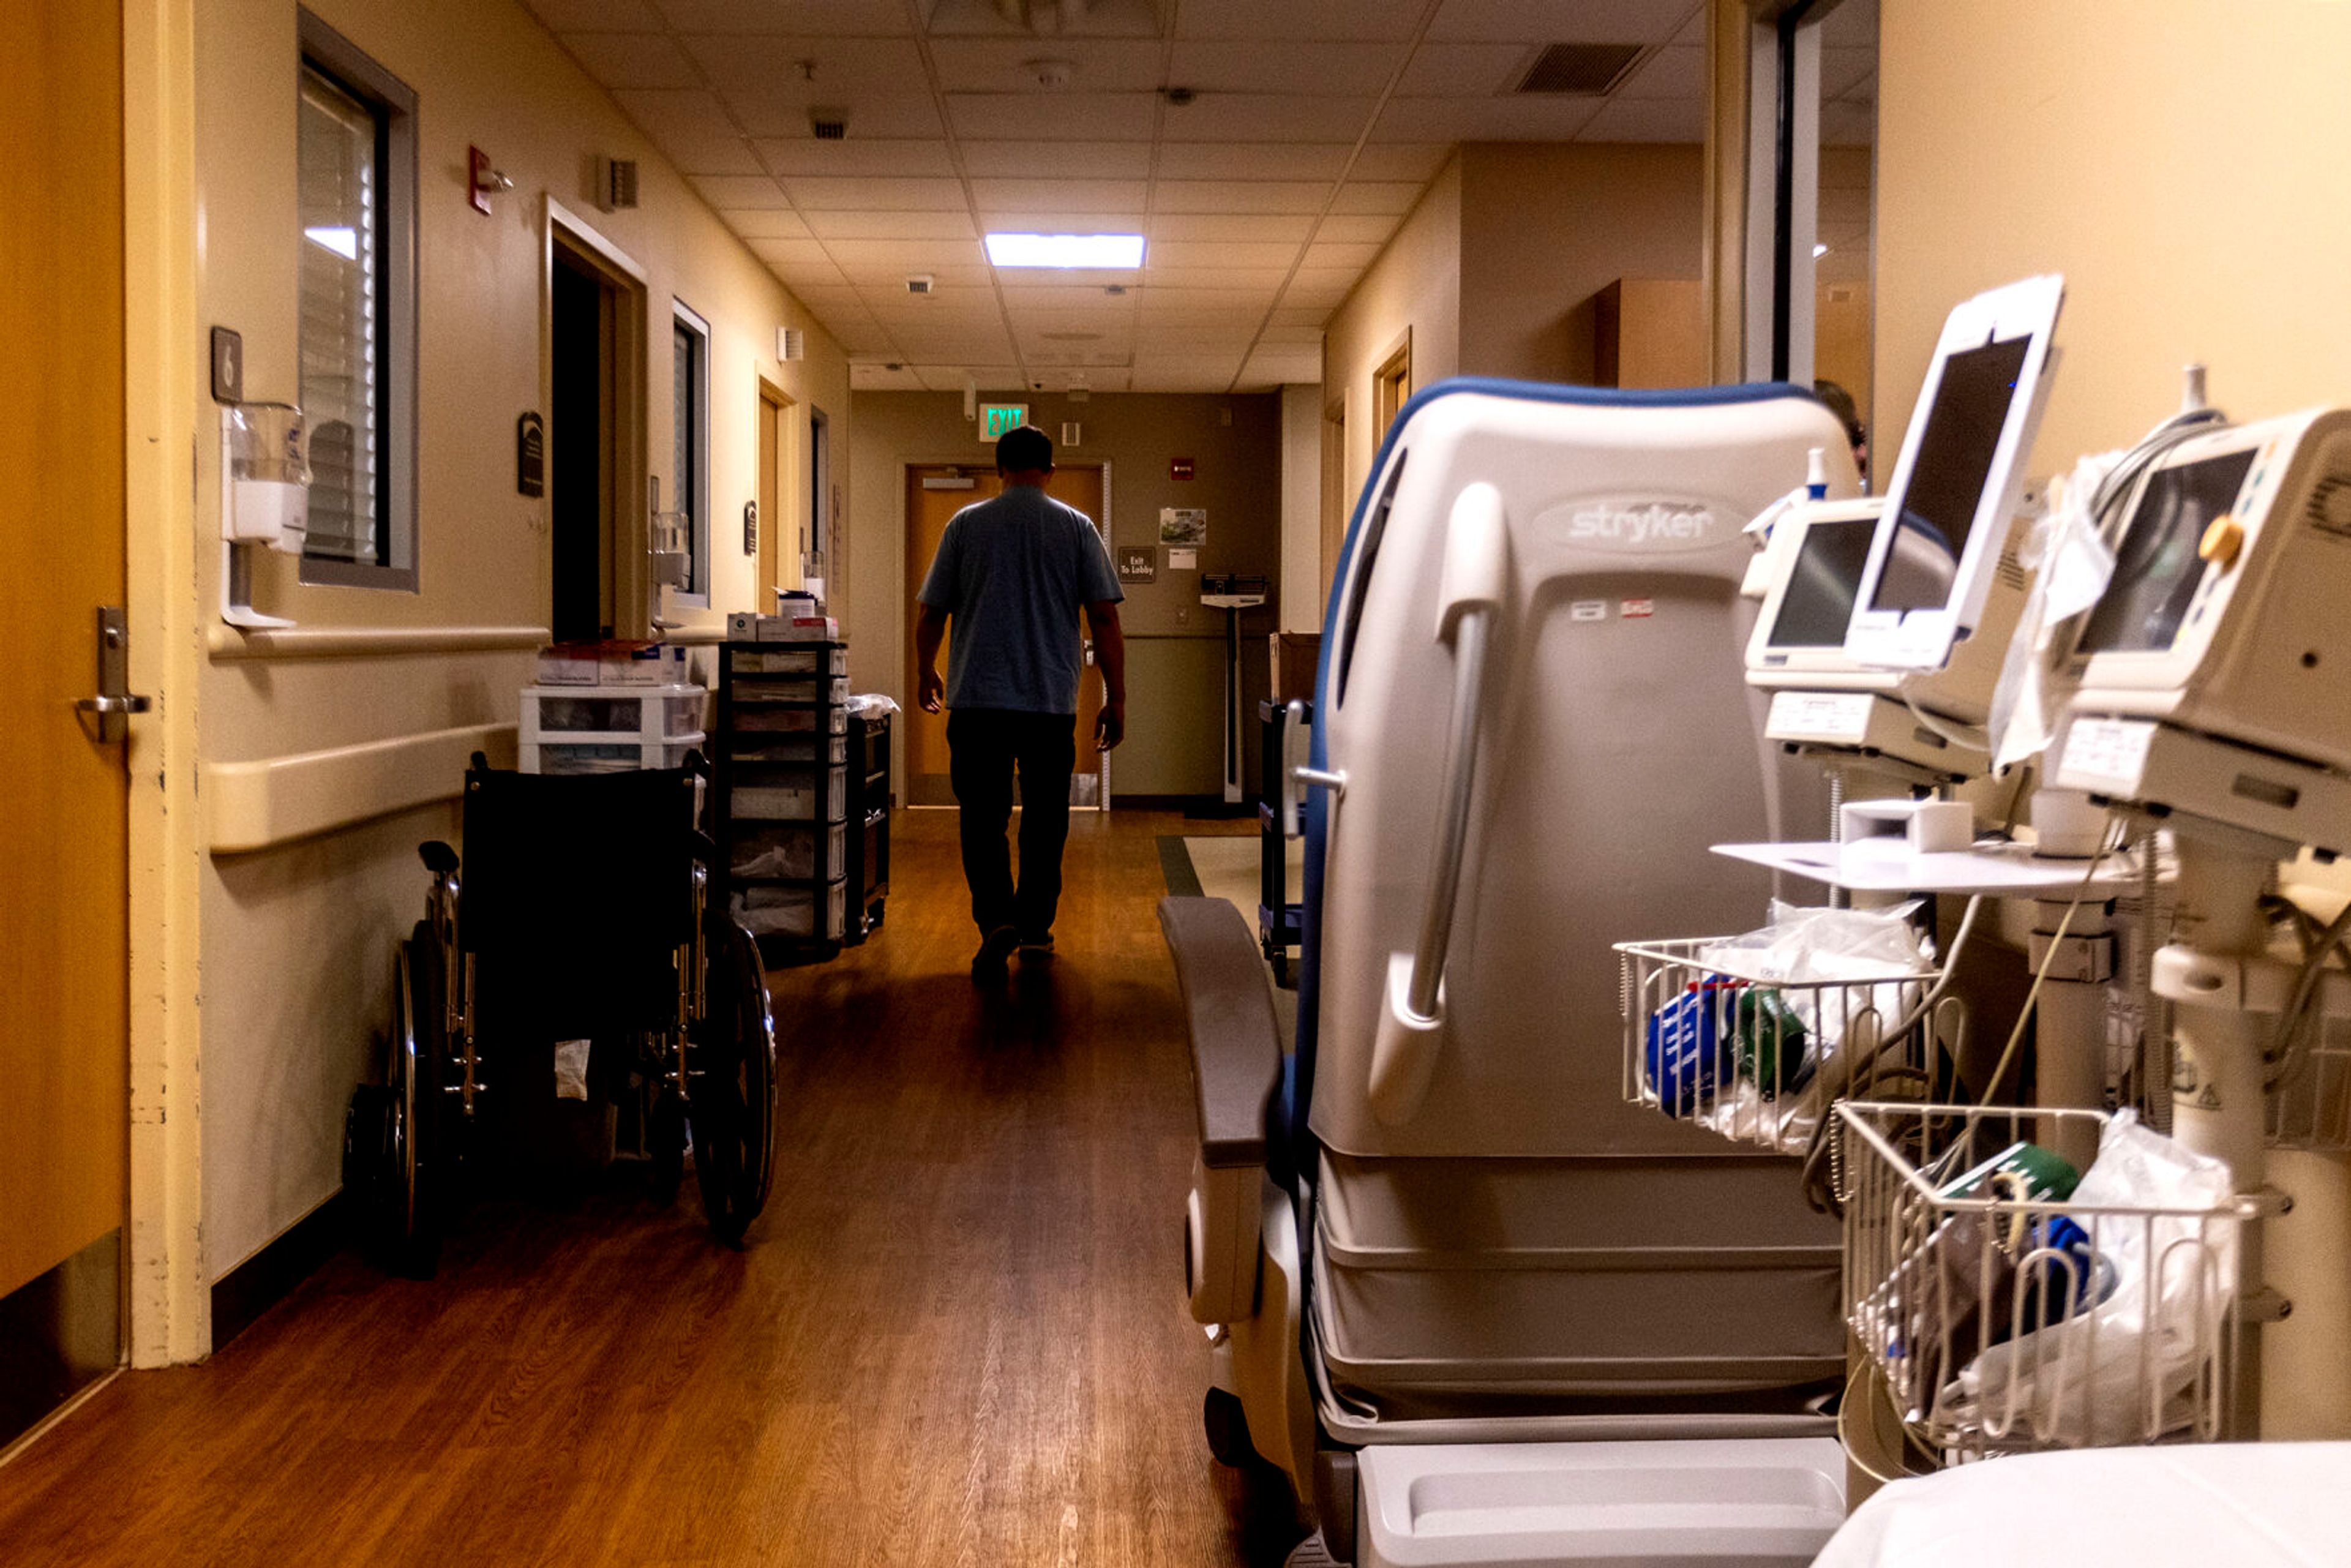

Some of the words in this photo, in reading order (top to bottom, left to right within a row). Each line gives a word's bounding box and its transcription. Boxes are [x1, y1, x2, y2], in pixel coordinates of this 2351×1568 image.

[223, 345, 233, 388] 6
[988, 408, 1022, 436] EXIT
[1569, 504, 1714, 544] stryker
[1120, 565, 1130, 574] To
[1131, 566, 1153, 576] Lobby
